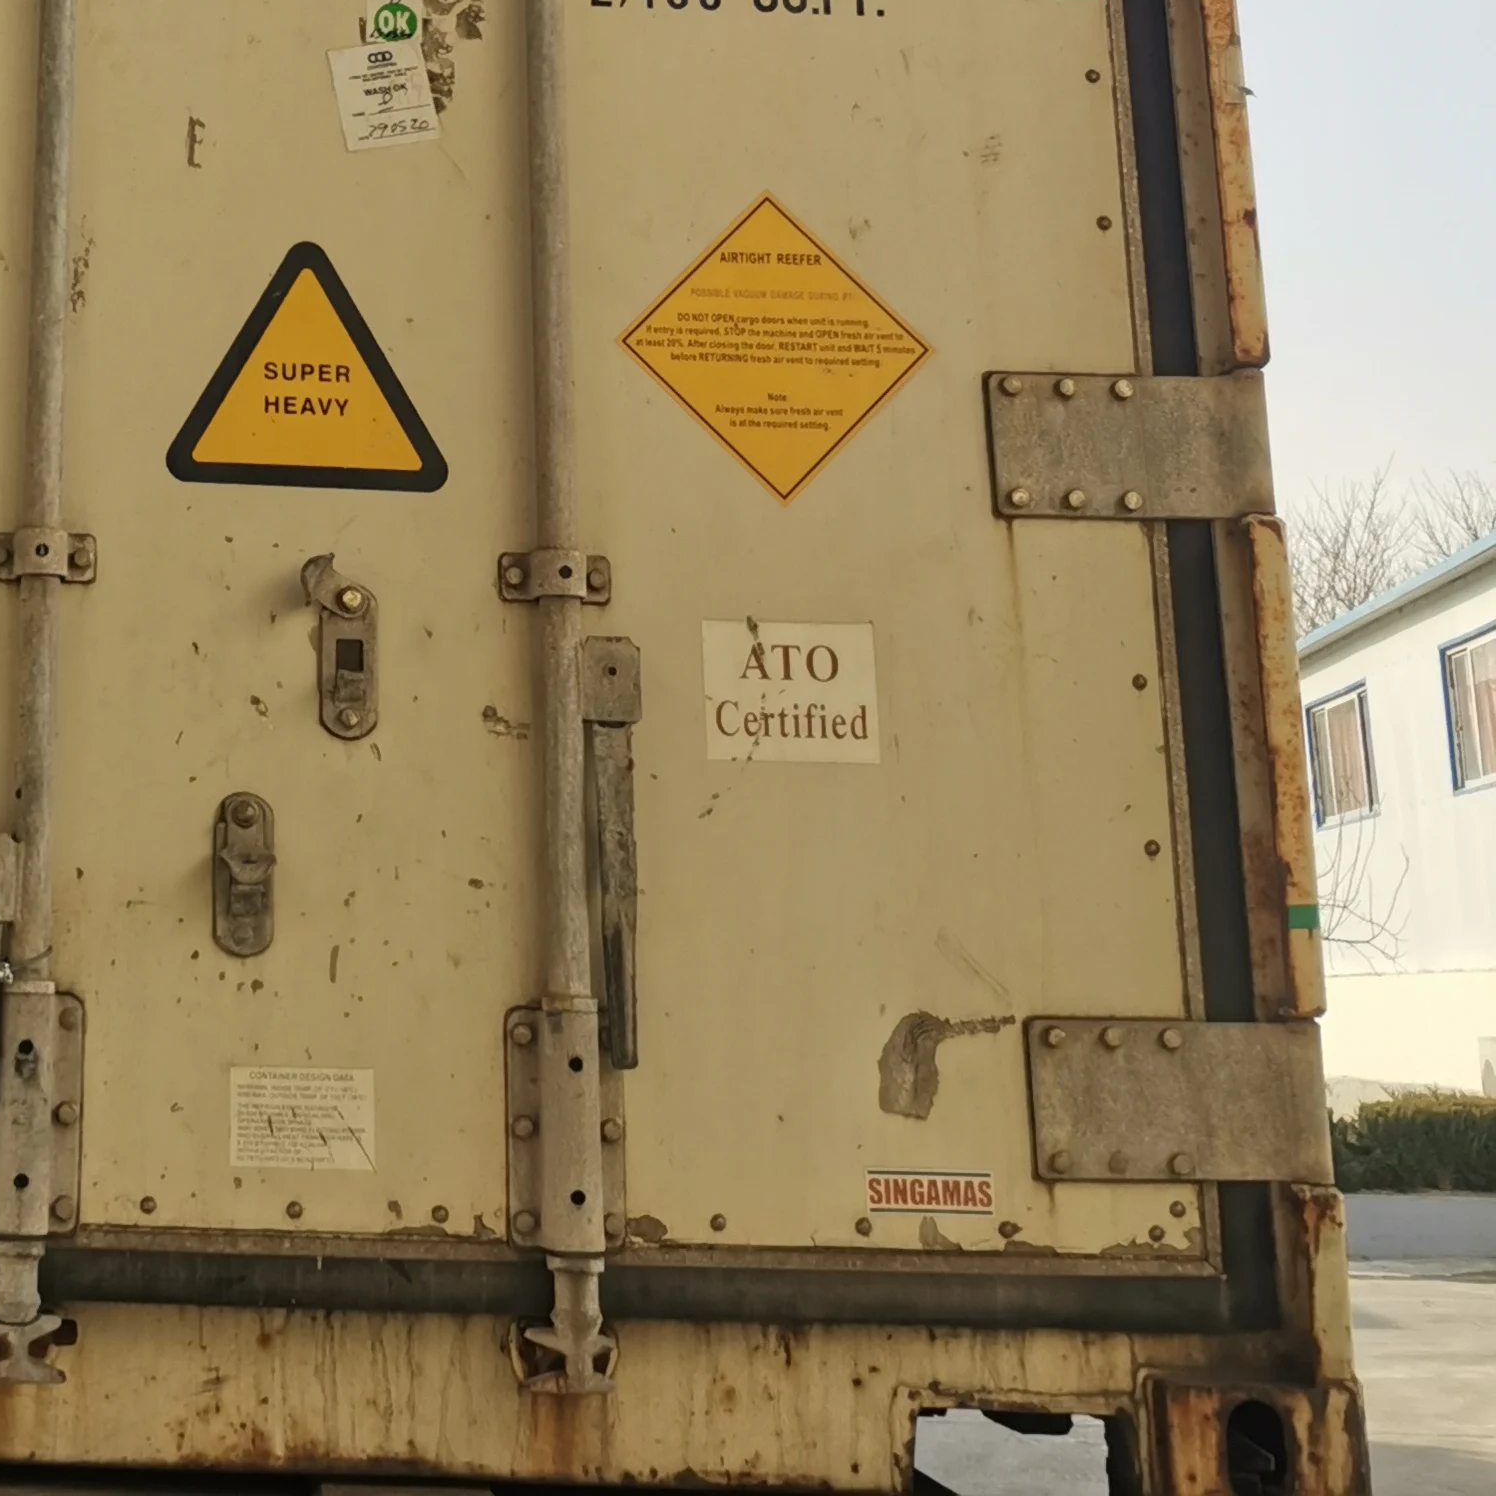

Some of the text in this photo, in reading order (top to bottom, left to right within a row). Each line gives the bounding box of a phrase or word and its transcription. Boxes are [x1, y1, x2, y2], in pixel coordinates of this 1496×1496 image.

[378, 10, 411, 34] OK
[720, 252, 822, 265] AIRTIGHT REEFER
[678, 313, 690, 321] DO
[692, 313, 708, 322] NOT
[711, 314, 734, 322] OPEN
[736, 316, 759, 325] cargo
[762, 315, 784, 324] doors
[787, 317, 808, 325] when
[646, 325, 651, 333] If
[654, 326, 674, 335] entry
[676, 326, 682, 334] is
[724, 328, 746, 336] STOP
[748, 328, 760, 336] the
[763, 330, 797, 338] machine
[799, 330, 813, 338] and
[815, 330, 839, 339] OPEN
[841, 331, 862, 339] fresh
[877, 332, 893, 340] vent
[688, 339, 706, 348] After
[709, 340, 739, 350] closing
[741, 341, 753, 349] the
[779, 342, 818, 352] RESTART
[820, 344, 835, 352] unit
[838, 344, 851, 352] and
[853, 344, 875, 353] WAIT
[671, 352, 696, 361] before
[699, 353, 748, 363] RETURNING
[750, 355, 771, 363] fresh
[773, 356, 783, 364] air
[786, 356, 803, 364] vent
[805, 356, 813, 364] to
[815, 357, 850, 366] required
[264, 362, 350, 383] SUPER
[264, 396, 349, 416] HEAVY
[715, 404, 744, 415] Always
[747, 406, 768, 414] make
[790, 407, 811, 416] fresh
[813, 408, 823, 416] air
[730, 419, 736, 427] is
[739, 419, 746, 427] at
[748, 419, 761, 427] the
[763, 420, 797, 429] required
[739, 642, 839, 683] ATO
[715, 700, 868, 740] Certified
[249, 1071, 354, 1081] CONTAINER DESIGN DATA
[868, 1178, 992, 1207] SINGAMAS
